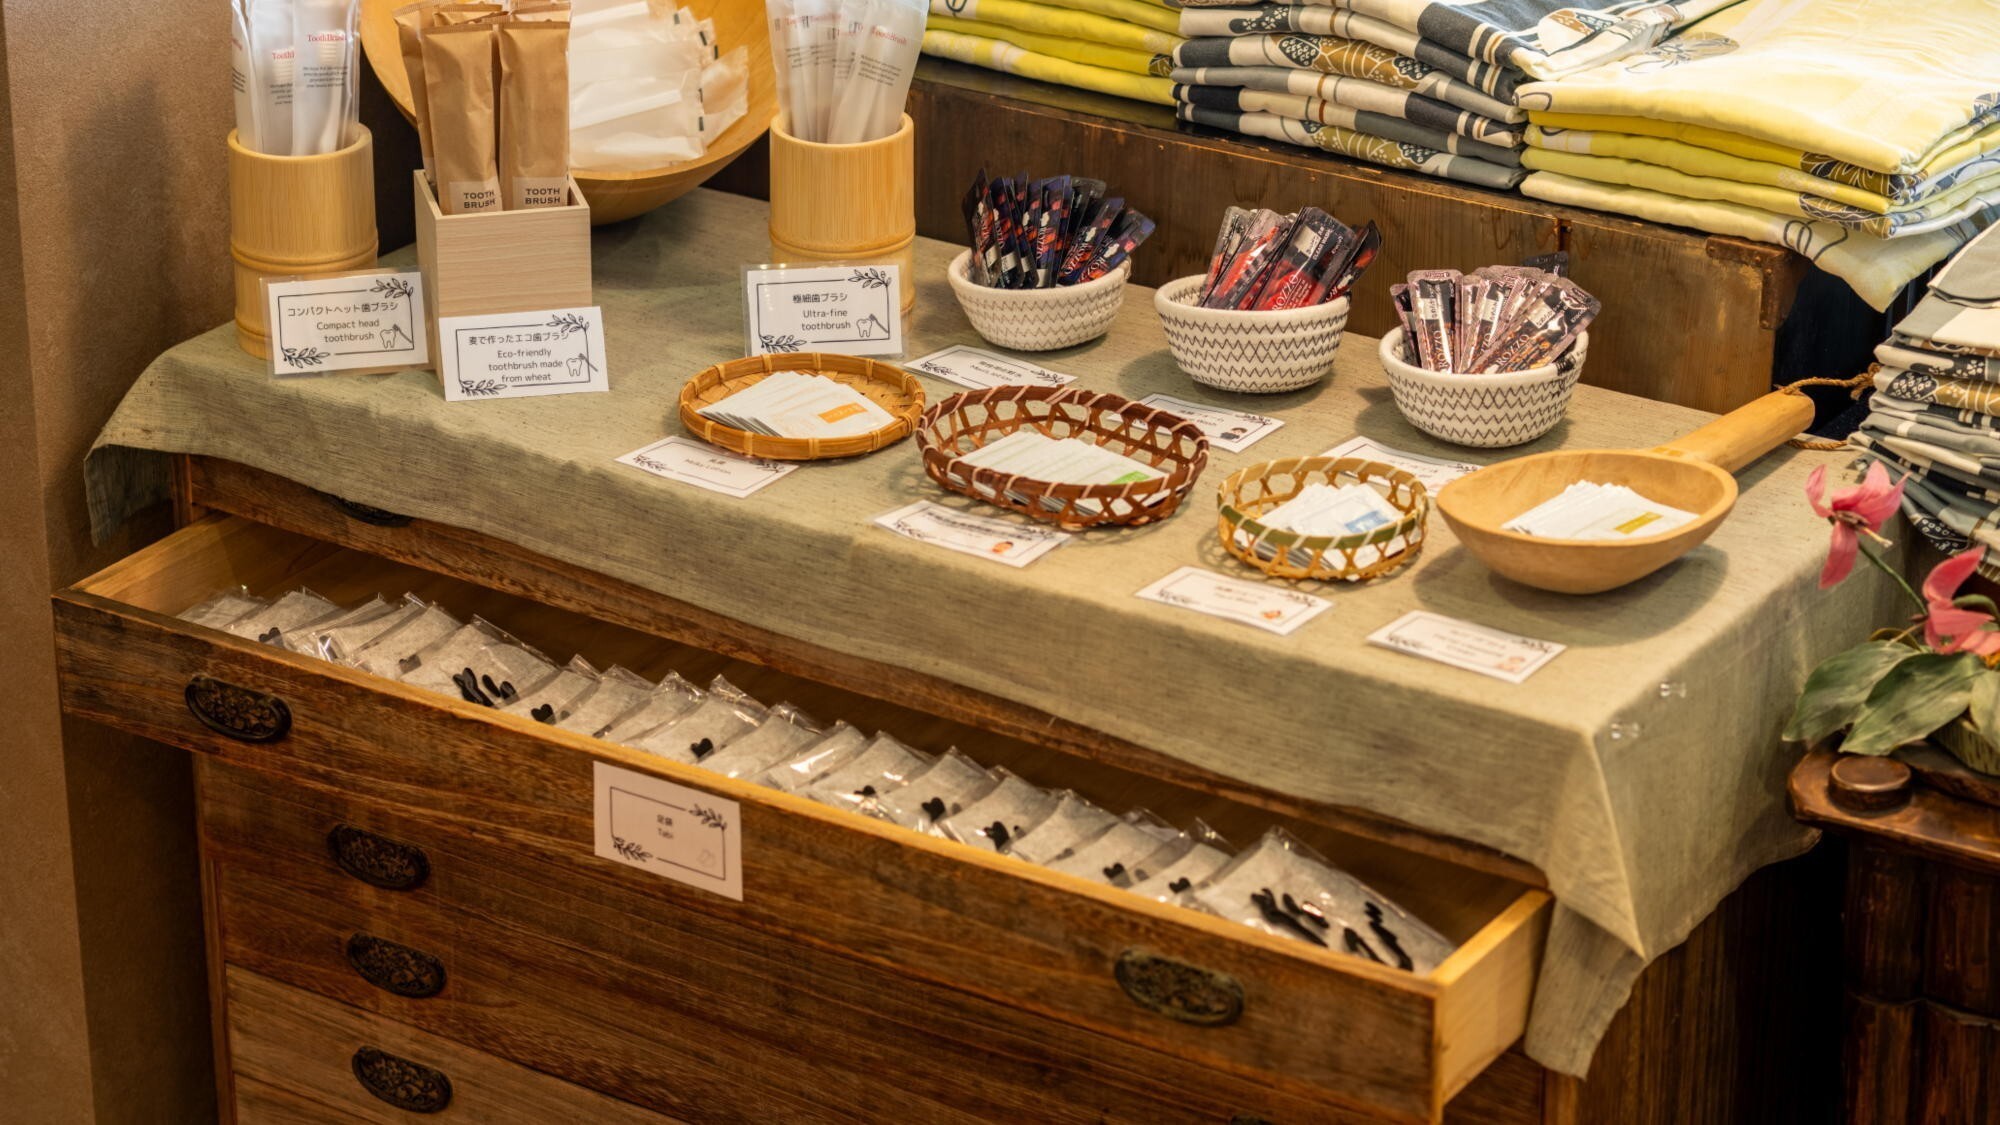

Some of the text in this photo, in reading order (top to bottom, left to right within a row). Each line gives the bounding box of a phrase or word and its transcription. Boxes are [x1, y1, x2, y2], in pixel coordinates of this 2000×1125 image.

[463, 190, 495, 199] TOOTH
[526, 188, 560, 196] TOOTH
[463, 199, 496, 209] BRUSH
[525, 197, 560, 205] BRUSH
[792, 292, 848, 304] 極細歯ブラシ
[803, 309, 848, 318] Ultra-fine
[316, 319, 380, 334] Compact head
[801, 321, 851, 331] toothbrush
[324, 332, 375, 343] toothbrush
[468, 331, 569, 346] 麦で作ったエコ歯ブラシ
[497, 348, 552, 358] Eco-friendly
[1496, 334, 1529, 366] ROZZO
[488, 360, 564, 371] toothbrush made
[501, 373, 552, 383] from wheat
